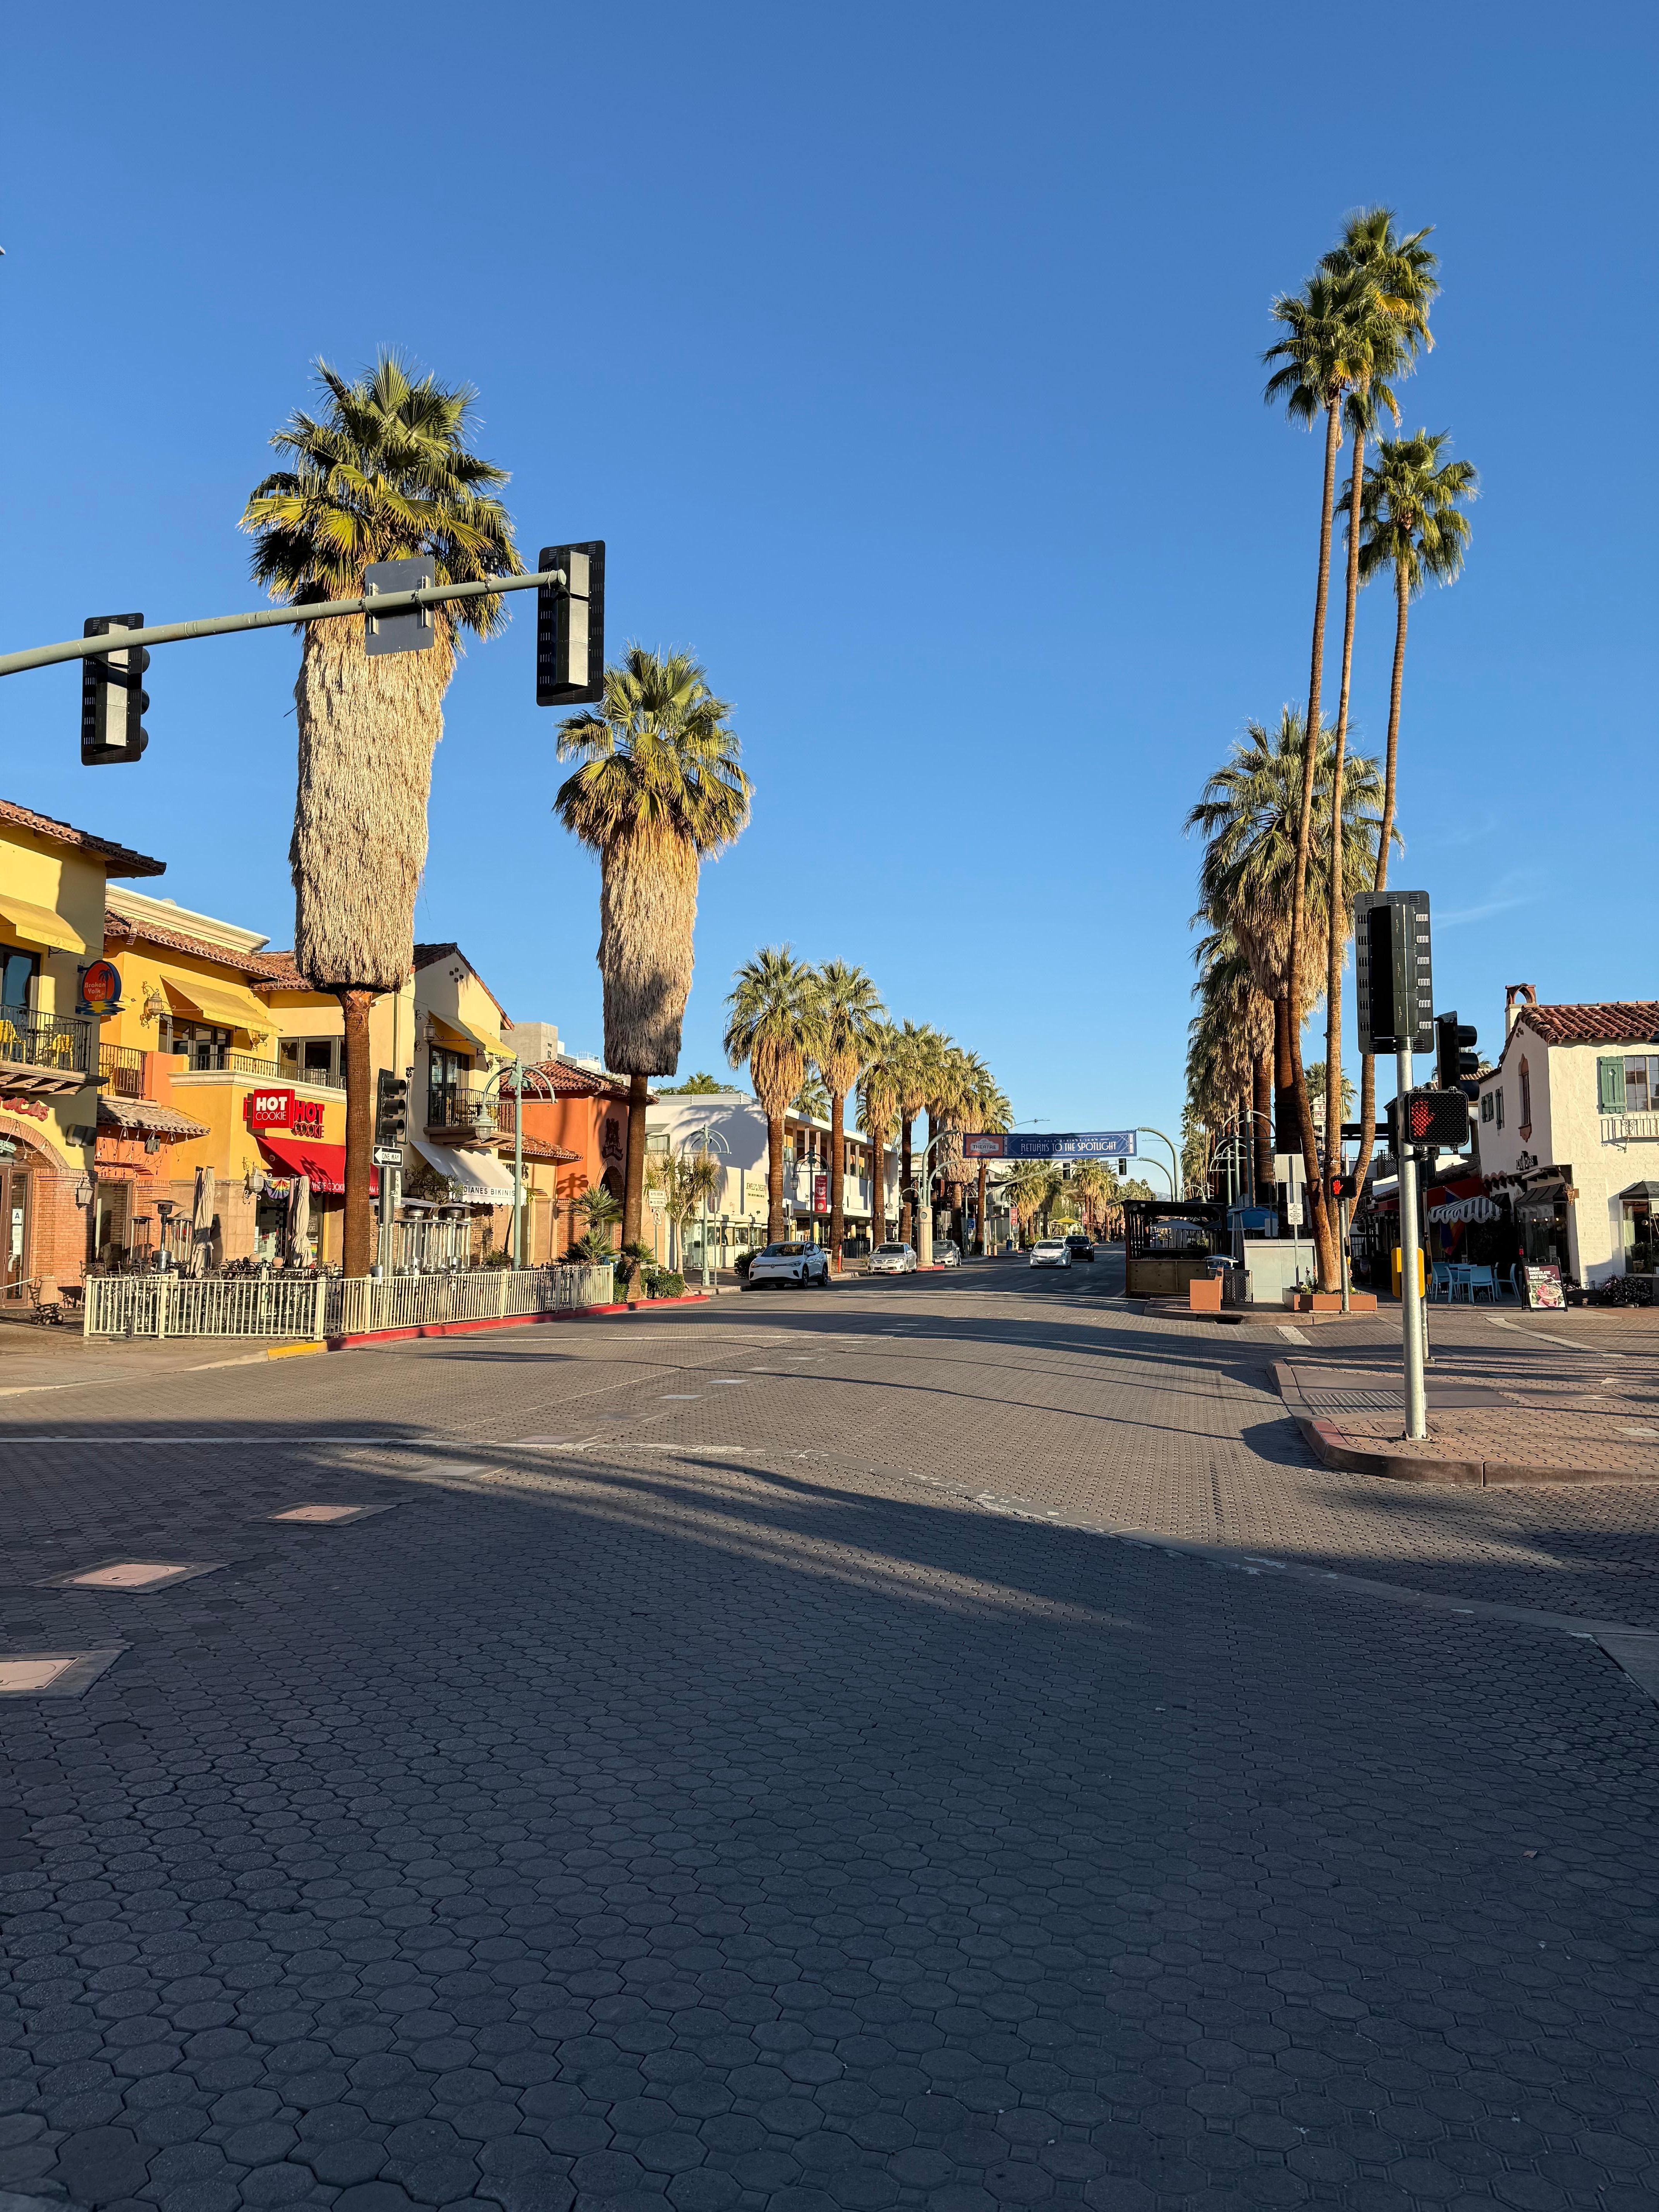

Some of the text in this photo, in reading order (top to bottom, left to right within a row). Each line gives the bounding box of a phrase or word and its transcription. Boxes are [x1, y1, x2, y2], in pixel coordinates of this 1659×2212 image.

[256, 1096, 287, 1111] HOT
[256, 1111, 287, 1120] COOKIE
[295, 1100, 325, 1125] HOT
[291, 1123, 325, 1139] COOKIE
[1021, 1141, 1116, 1152] RETURNS TO THE SPOTLIGHT
